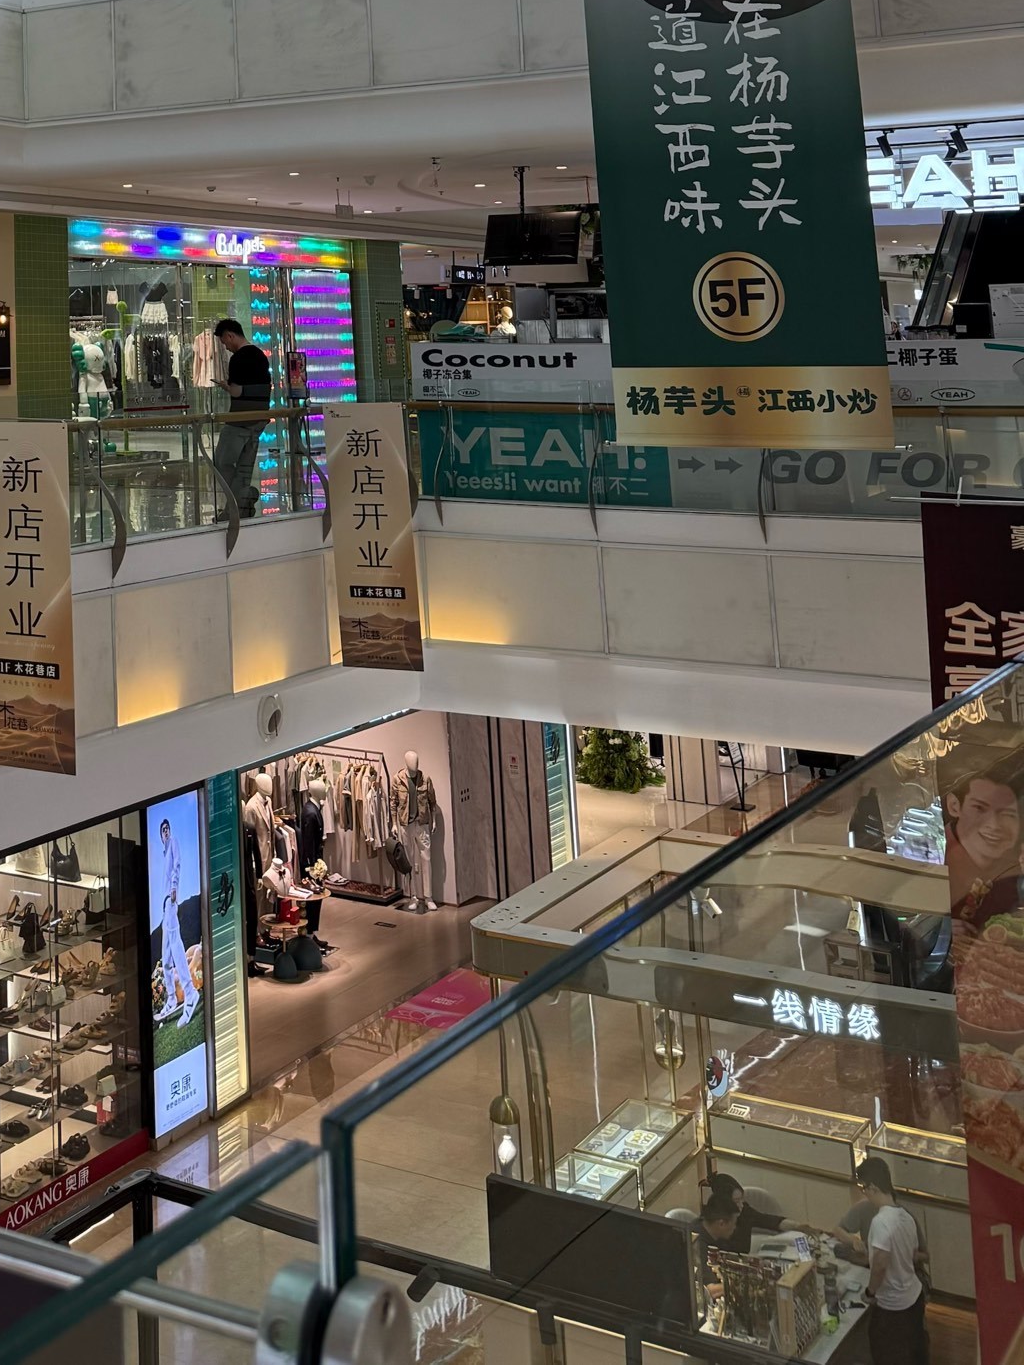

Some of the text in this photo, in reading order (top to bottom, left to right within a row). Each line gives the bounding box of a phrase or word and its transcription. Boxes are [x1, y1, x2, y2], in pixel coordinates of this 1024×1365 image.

[708, 276, 766, 319] 5F
[421, 348, 578, 369] Coconut
[626, 386, 737, 417] 杨芋头
[756, 387, 878, 416] 江西小炒
[937, 389, 969, 399] YEAH
[440, 426, 648, 471] YEAH!
[524, 477, 582, 495] want
[763, 449, 847, 486] GO
[866, 451, 991, 489] FOR
[346, 429, 393, 570] 新店开业
[1, 455, 47, 639] 新店开业
[14, 661, 56, 678] 木花巷店
[732, 988, 881, 1040] 一线情缘
[170, 1072, 192, 1101] 奥康
[5, 1166, 90, 1232] AOKANG 奥康
